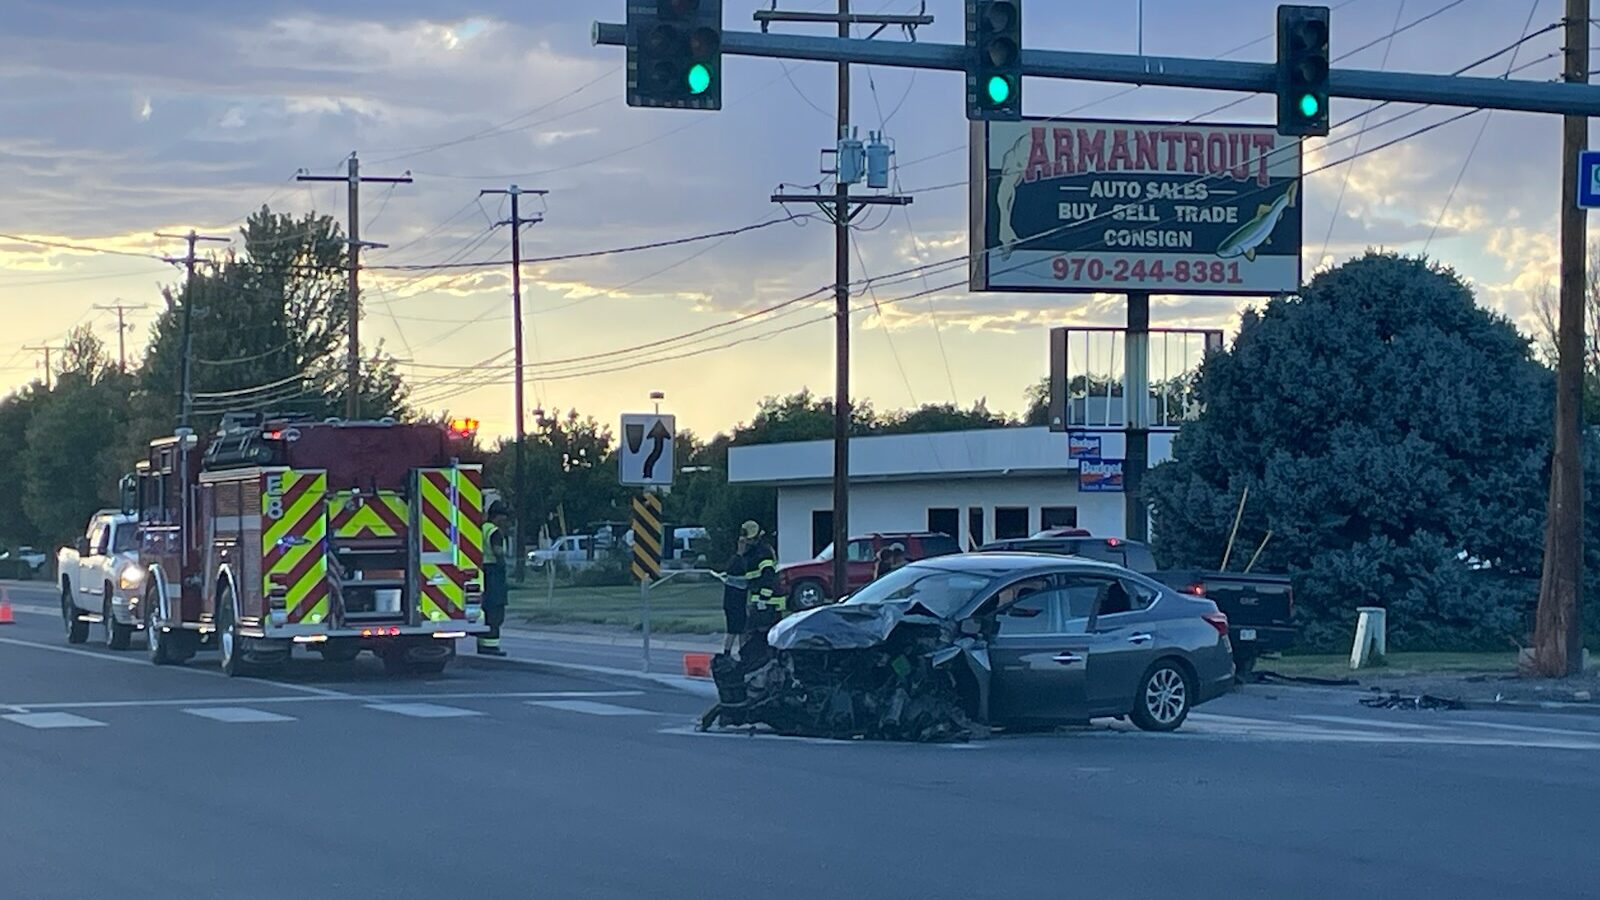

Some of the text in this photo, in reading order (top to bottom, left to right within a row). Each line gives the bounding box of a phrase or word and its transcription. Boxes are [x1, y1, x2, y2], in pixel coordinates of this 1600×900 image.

[1025, 127, 1275, 188] ARMANTROUT
[1089, 181, 1209, 201] AUTO SALES
[1058, 203, 1238, 223] BUY SELL TRADE
[1104, 230, 1192, 248] CONSIGN
[1052, 258, 1243, 284] 970-244-8381
[1081, 461, 1123, 478] Budget
[267, 475, 284, 520] E8
[1239, 597, 1260, 606] GC
